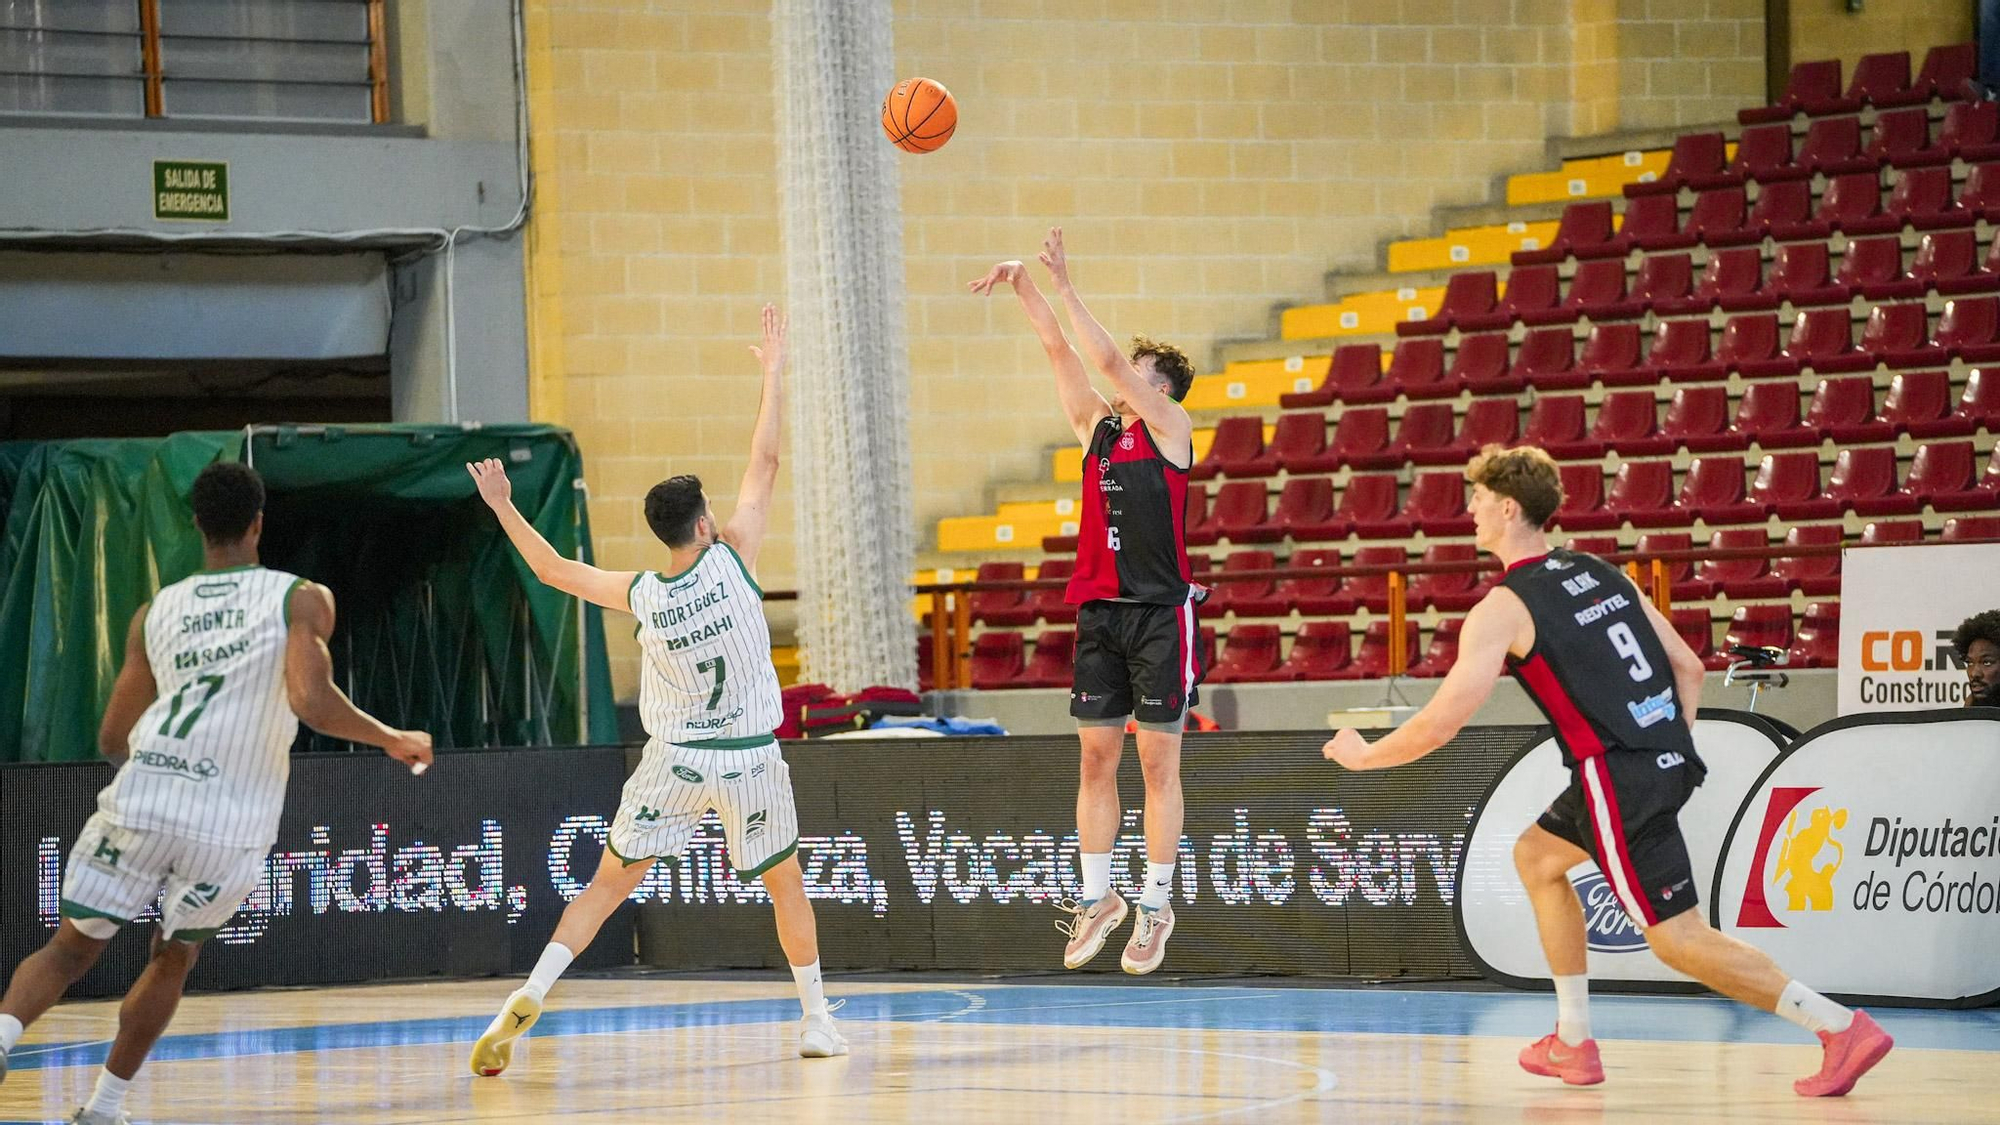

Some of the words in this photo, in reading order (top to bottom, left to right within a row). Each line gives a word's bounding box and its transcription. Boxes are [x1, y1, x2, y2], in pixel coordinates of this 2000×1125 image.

[165, 168, 201, 189] SALIDA
[203, 169, 216, 189] DE
[159, 193, 224, 213] EMERGENCIA
[182, 609, 245, 634] SAGNIA
[1574, 593, 1630, 626] REDYTEL
[690, 615, 733, 644] RAHI
[1606, 621, 1653, 682] 9
[696, 655, 726, 711] 7
[158, 675, 225, 740] 17
[133, 750, 189, 772] PIEDRA
[1208, 808, 1295, 905] de
[1864, 816, 2000, 867] Diputaci
[1853, 870, 1891, 911] de
[1902, 870, 2000, 914] Córdo
